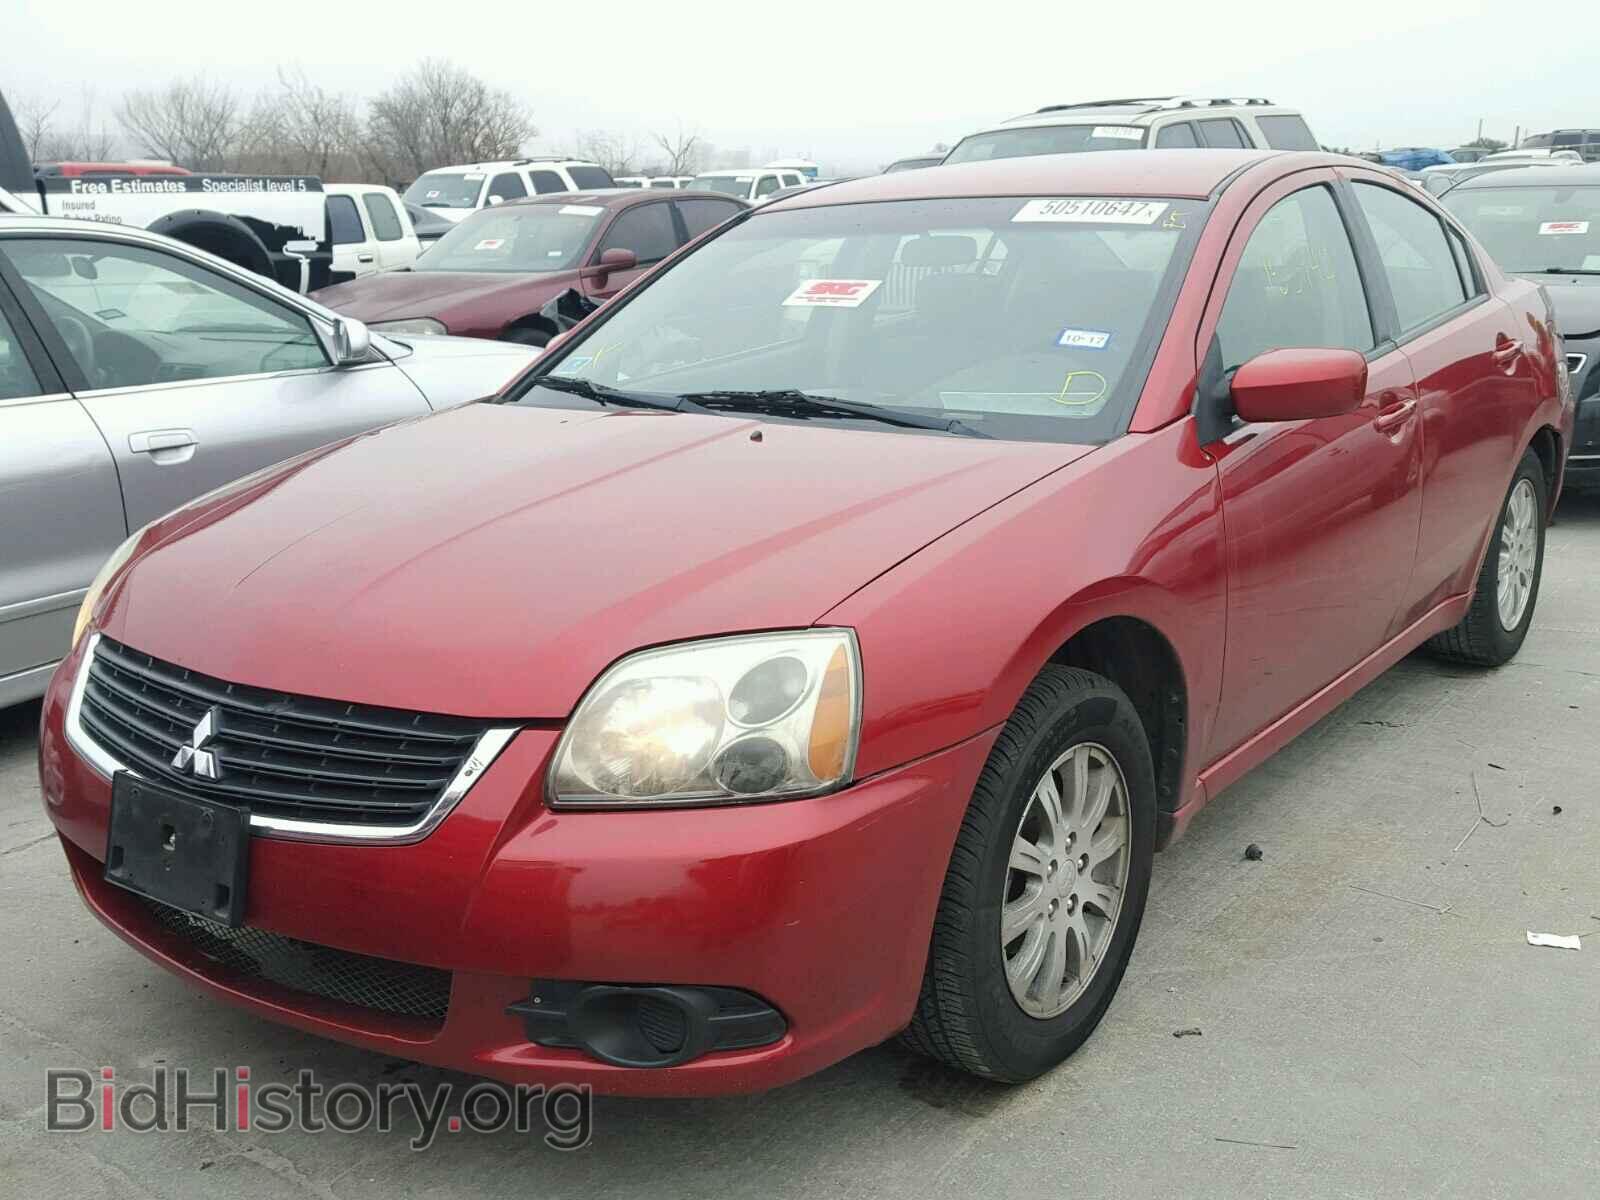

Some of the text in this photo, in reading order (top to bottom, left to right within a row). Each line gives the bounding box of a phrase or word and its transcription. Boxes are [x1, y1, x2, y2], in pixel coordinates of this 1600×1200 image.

[71, 179, 306, 193] Free Estimates Specialist level 5
[62, 200, 96, 210] Insured
[1039, 200, 1149, 217] 50510647
